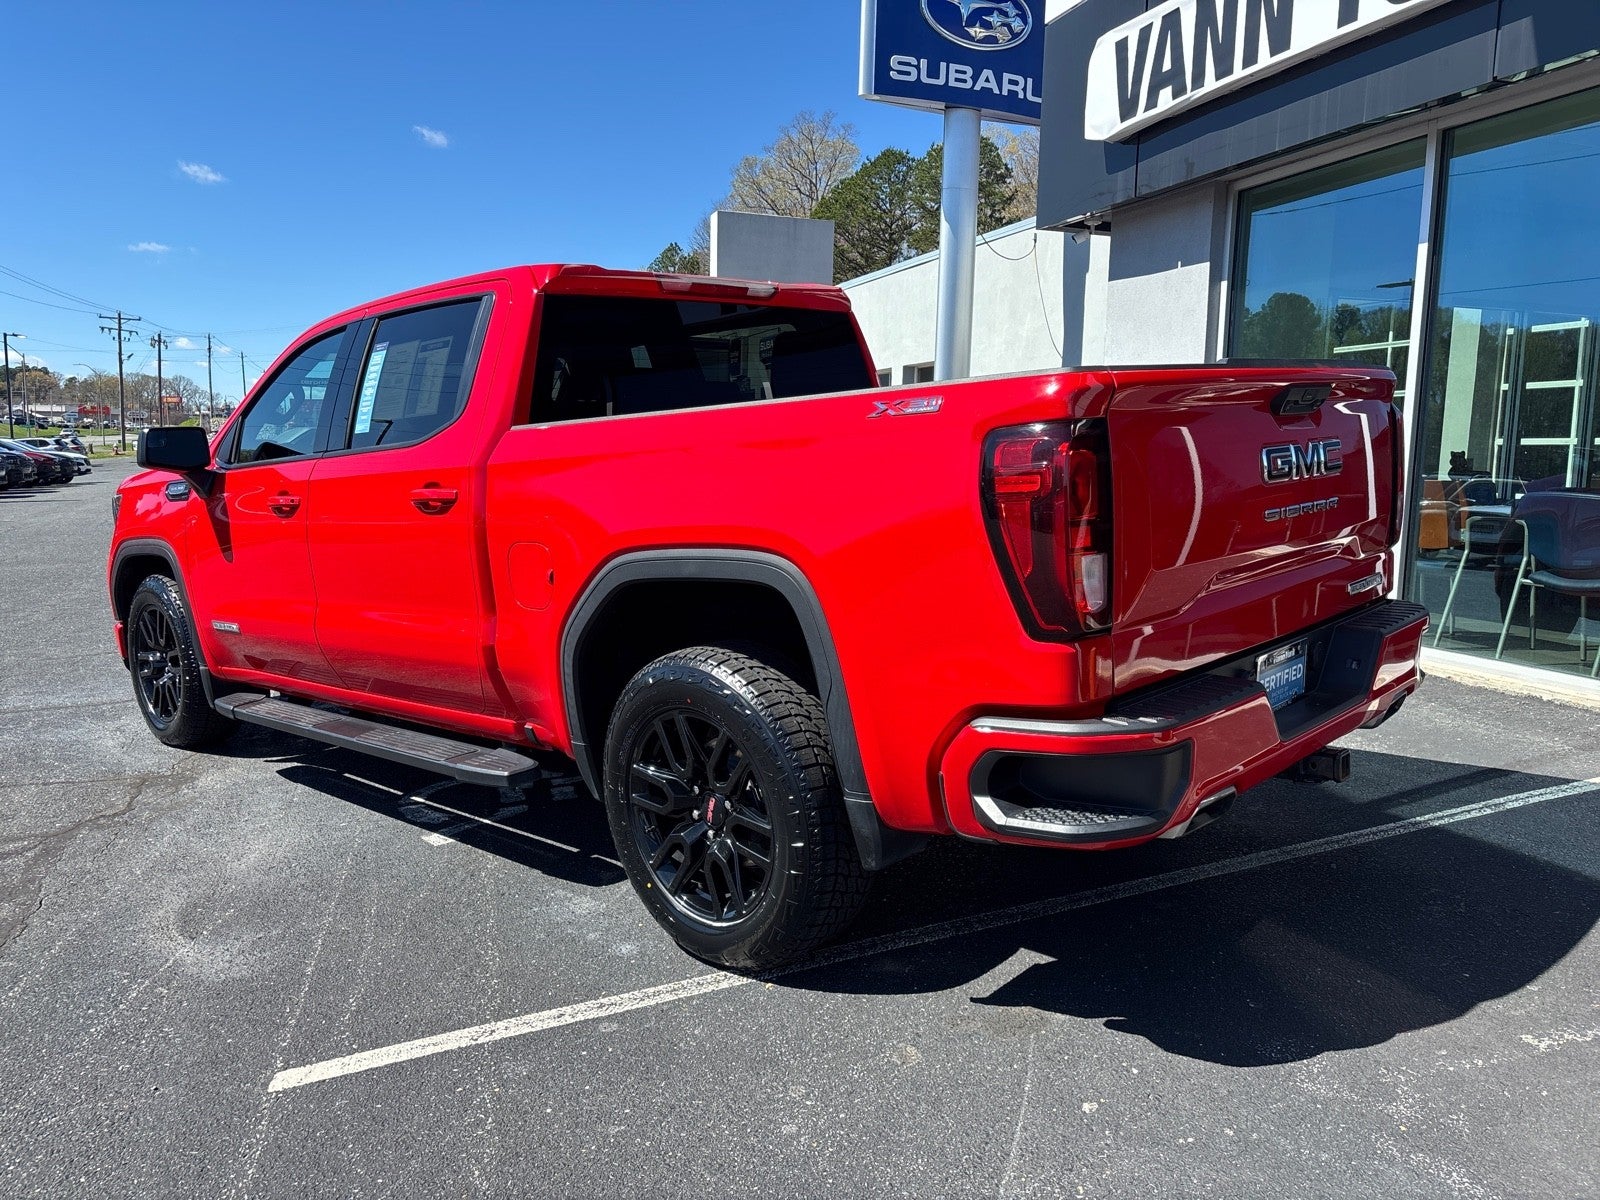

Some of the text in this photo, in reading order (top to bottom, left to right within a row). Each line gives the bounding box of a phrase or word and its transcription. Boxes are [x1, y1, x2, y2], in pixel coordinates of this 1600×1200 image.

[1115, 0, 1295, 123] VANN
[1261, 438, 1343, 485] GMC
[1264, 497, 1339, 522] SIERRA
